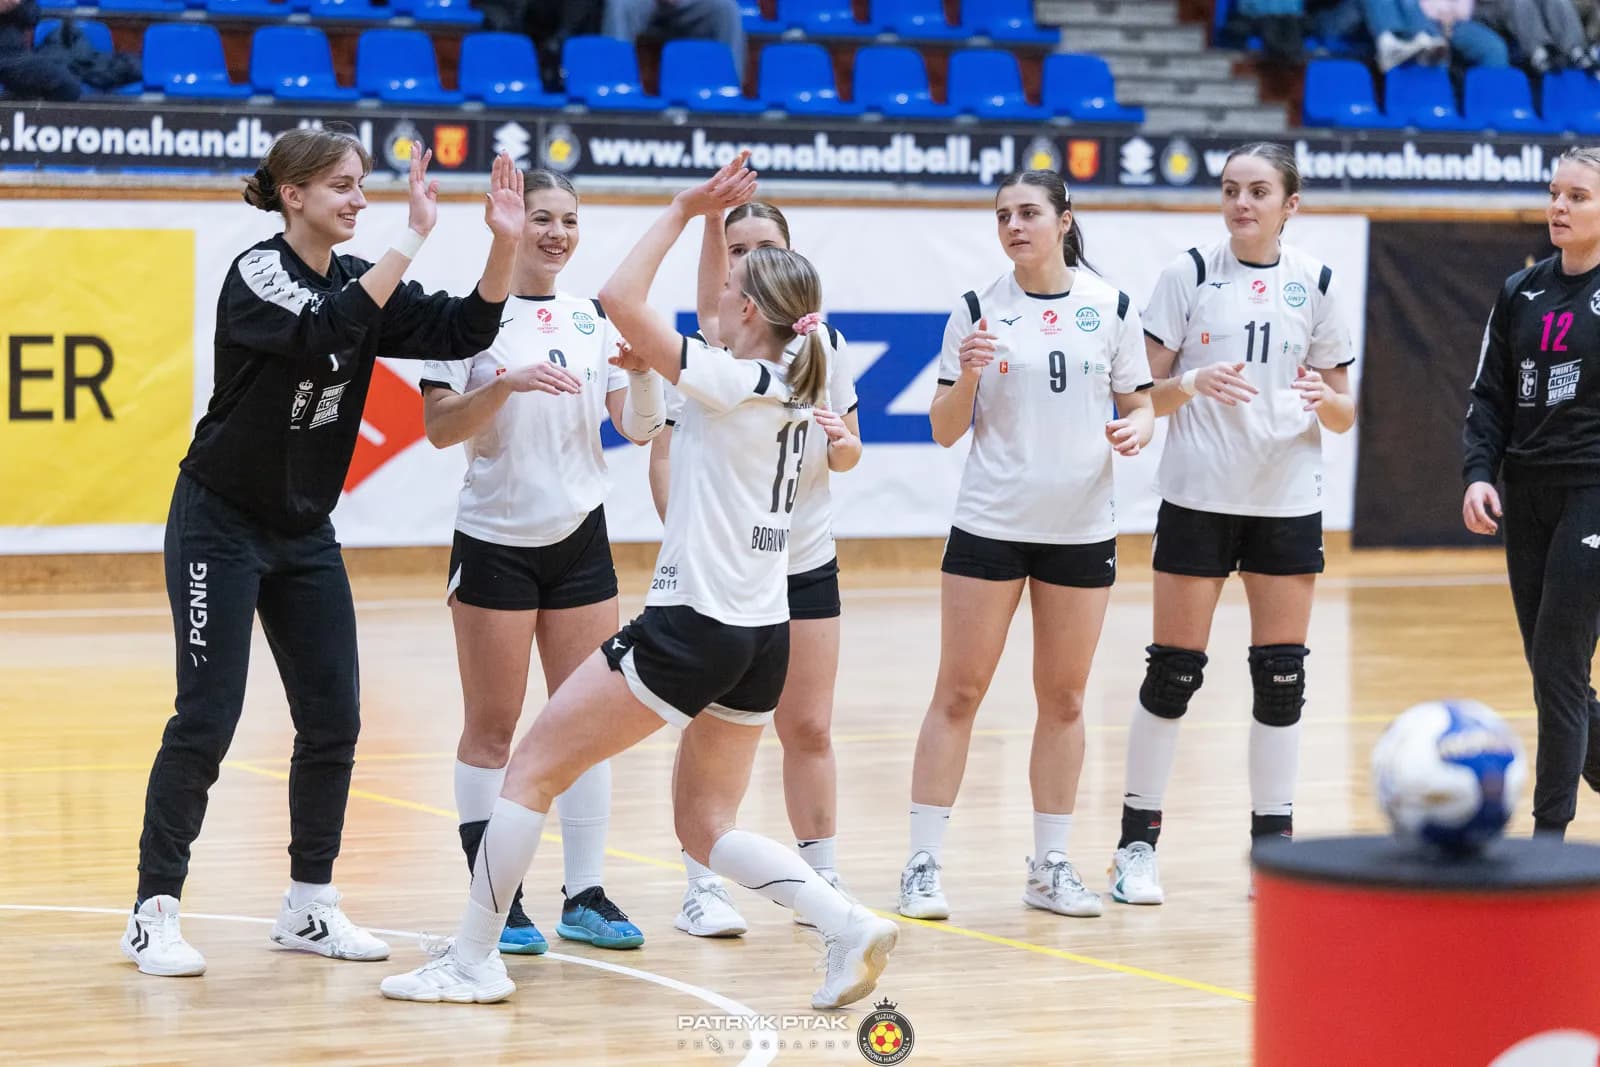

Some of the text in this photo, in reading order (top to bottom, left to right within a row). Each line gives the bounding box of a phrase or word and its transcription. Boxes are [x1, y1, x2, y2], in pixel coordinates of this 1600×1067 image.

[1244, 321, 1271, 364] 11
[1540, 311, 1574, 351] 12
[1048, 350, 1067, 393] 9
[770, 420, 808, 513] 13
[189, 562, 208, 647] PGNiG
[651, 578, 677, 590] 2011
